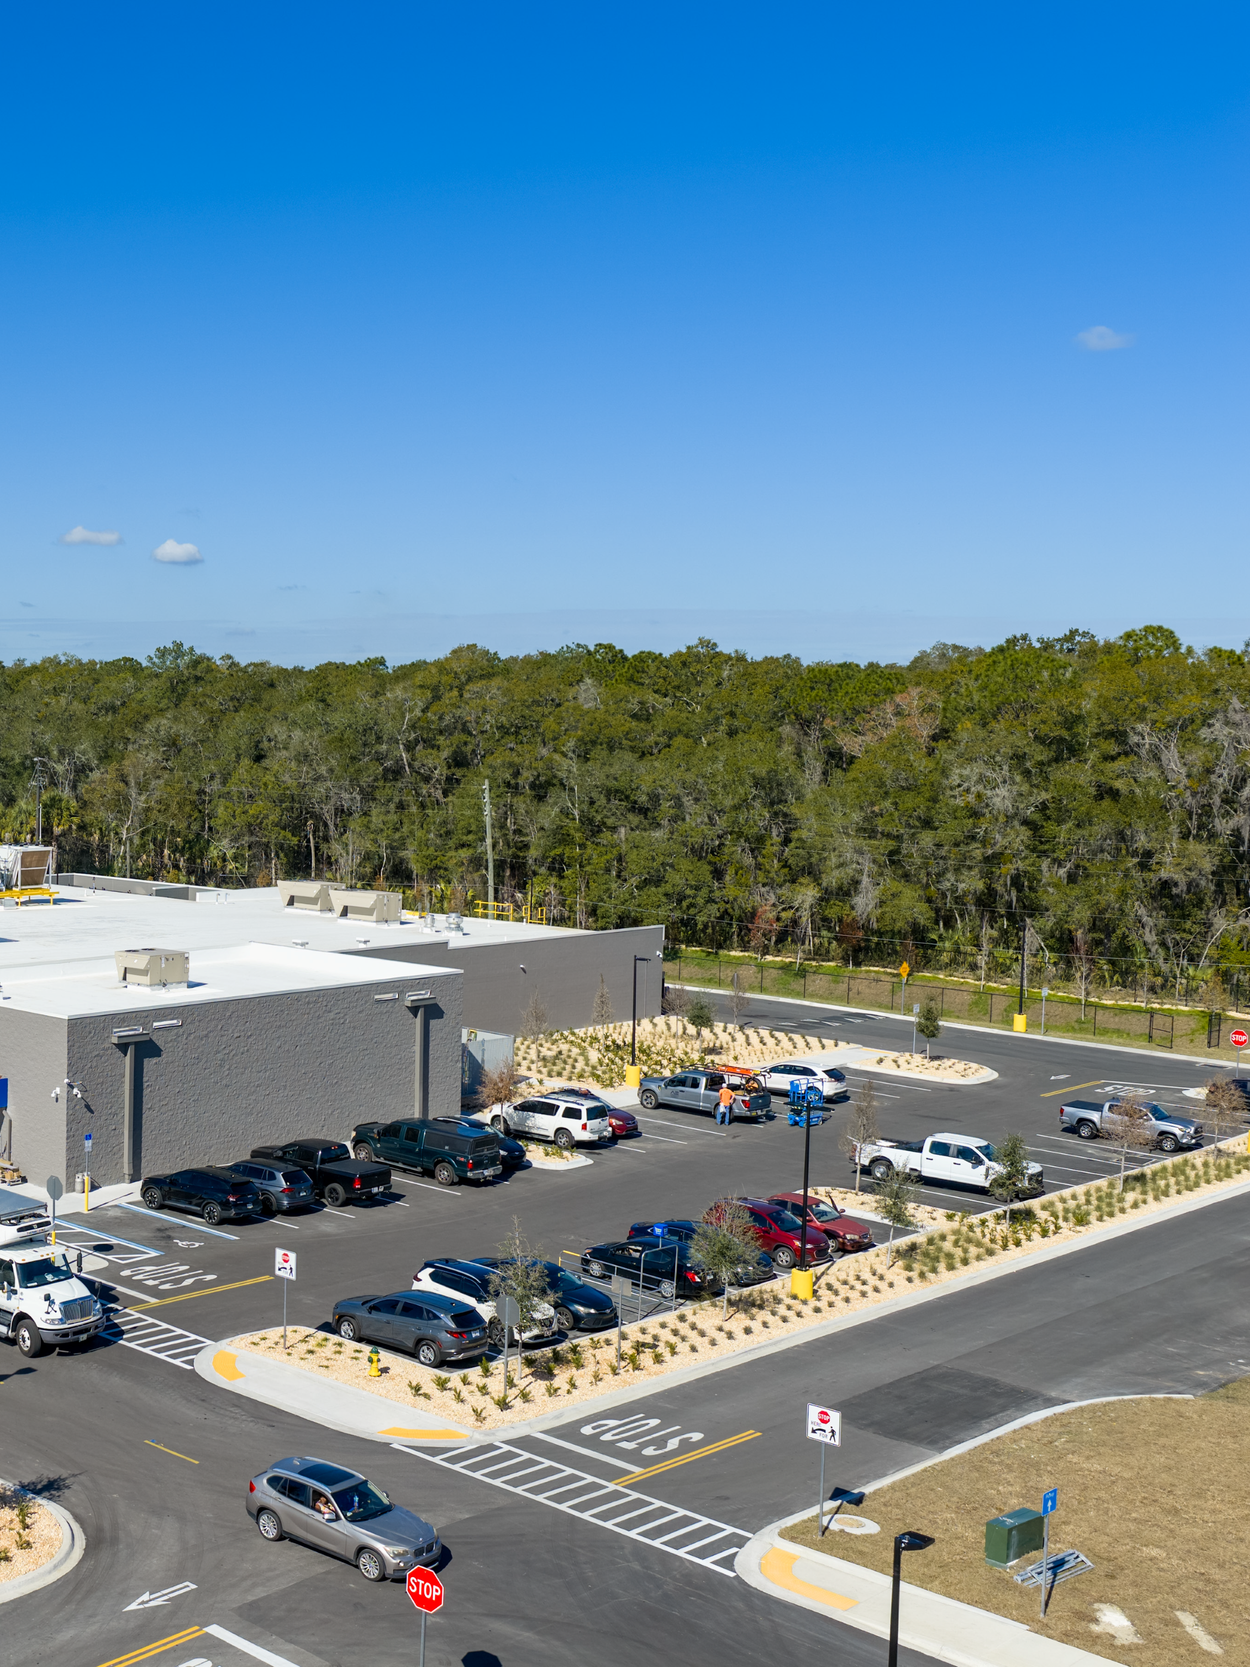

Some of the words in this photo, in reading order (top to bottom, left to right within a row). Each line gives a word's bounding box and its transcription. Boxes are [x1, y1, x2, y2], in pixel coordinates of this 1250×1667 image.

[1231, 1034, 1247, 1042] STOP
[1094, 1085, 1157, 1096] STOP
[119, 1262, 218, 1290] STOP
[580, 1413, 704, 1456] STOP
[409, 1576, 441, 1601] STOP
